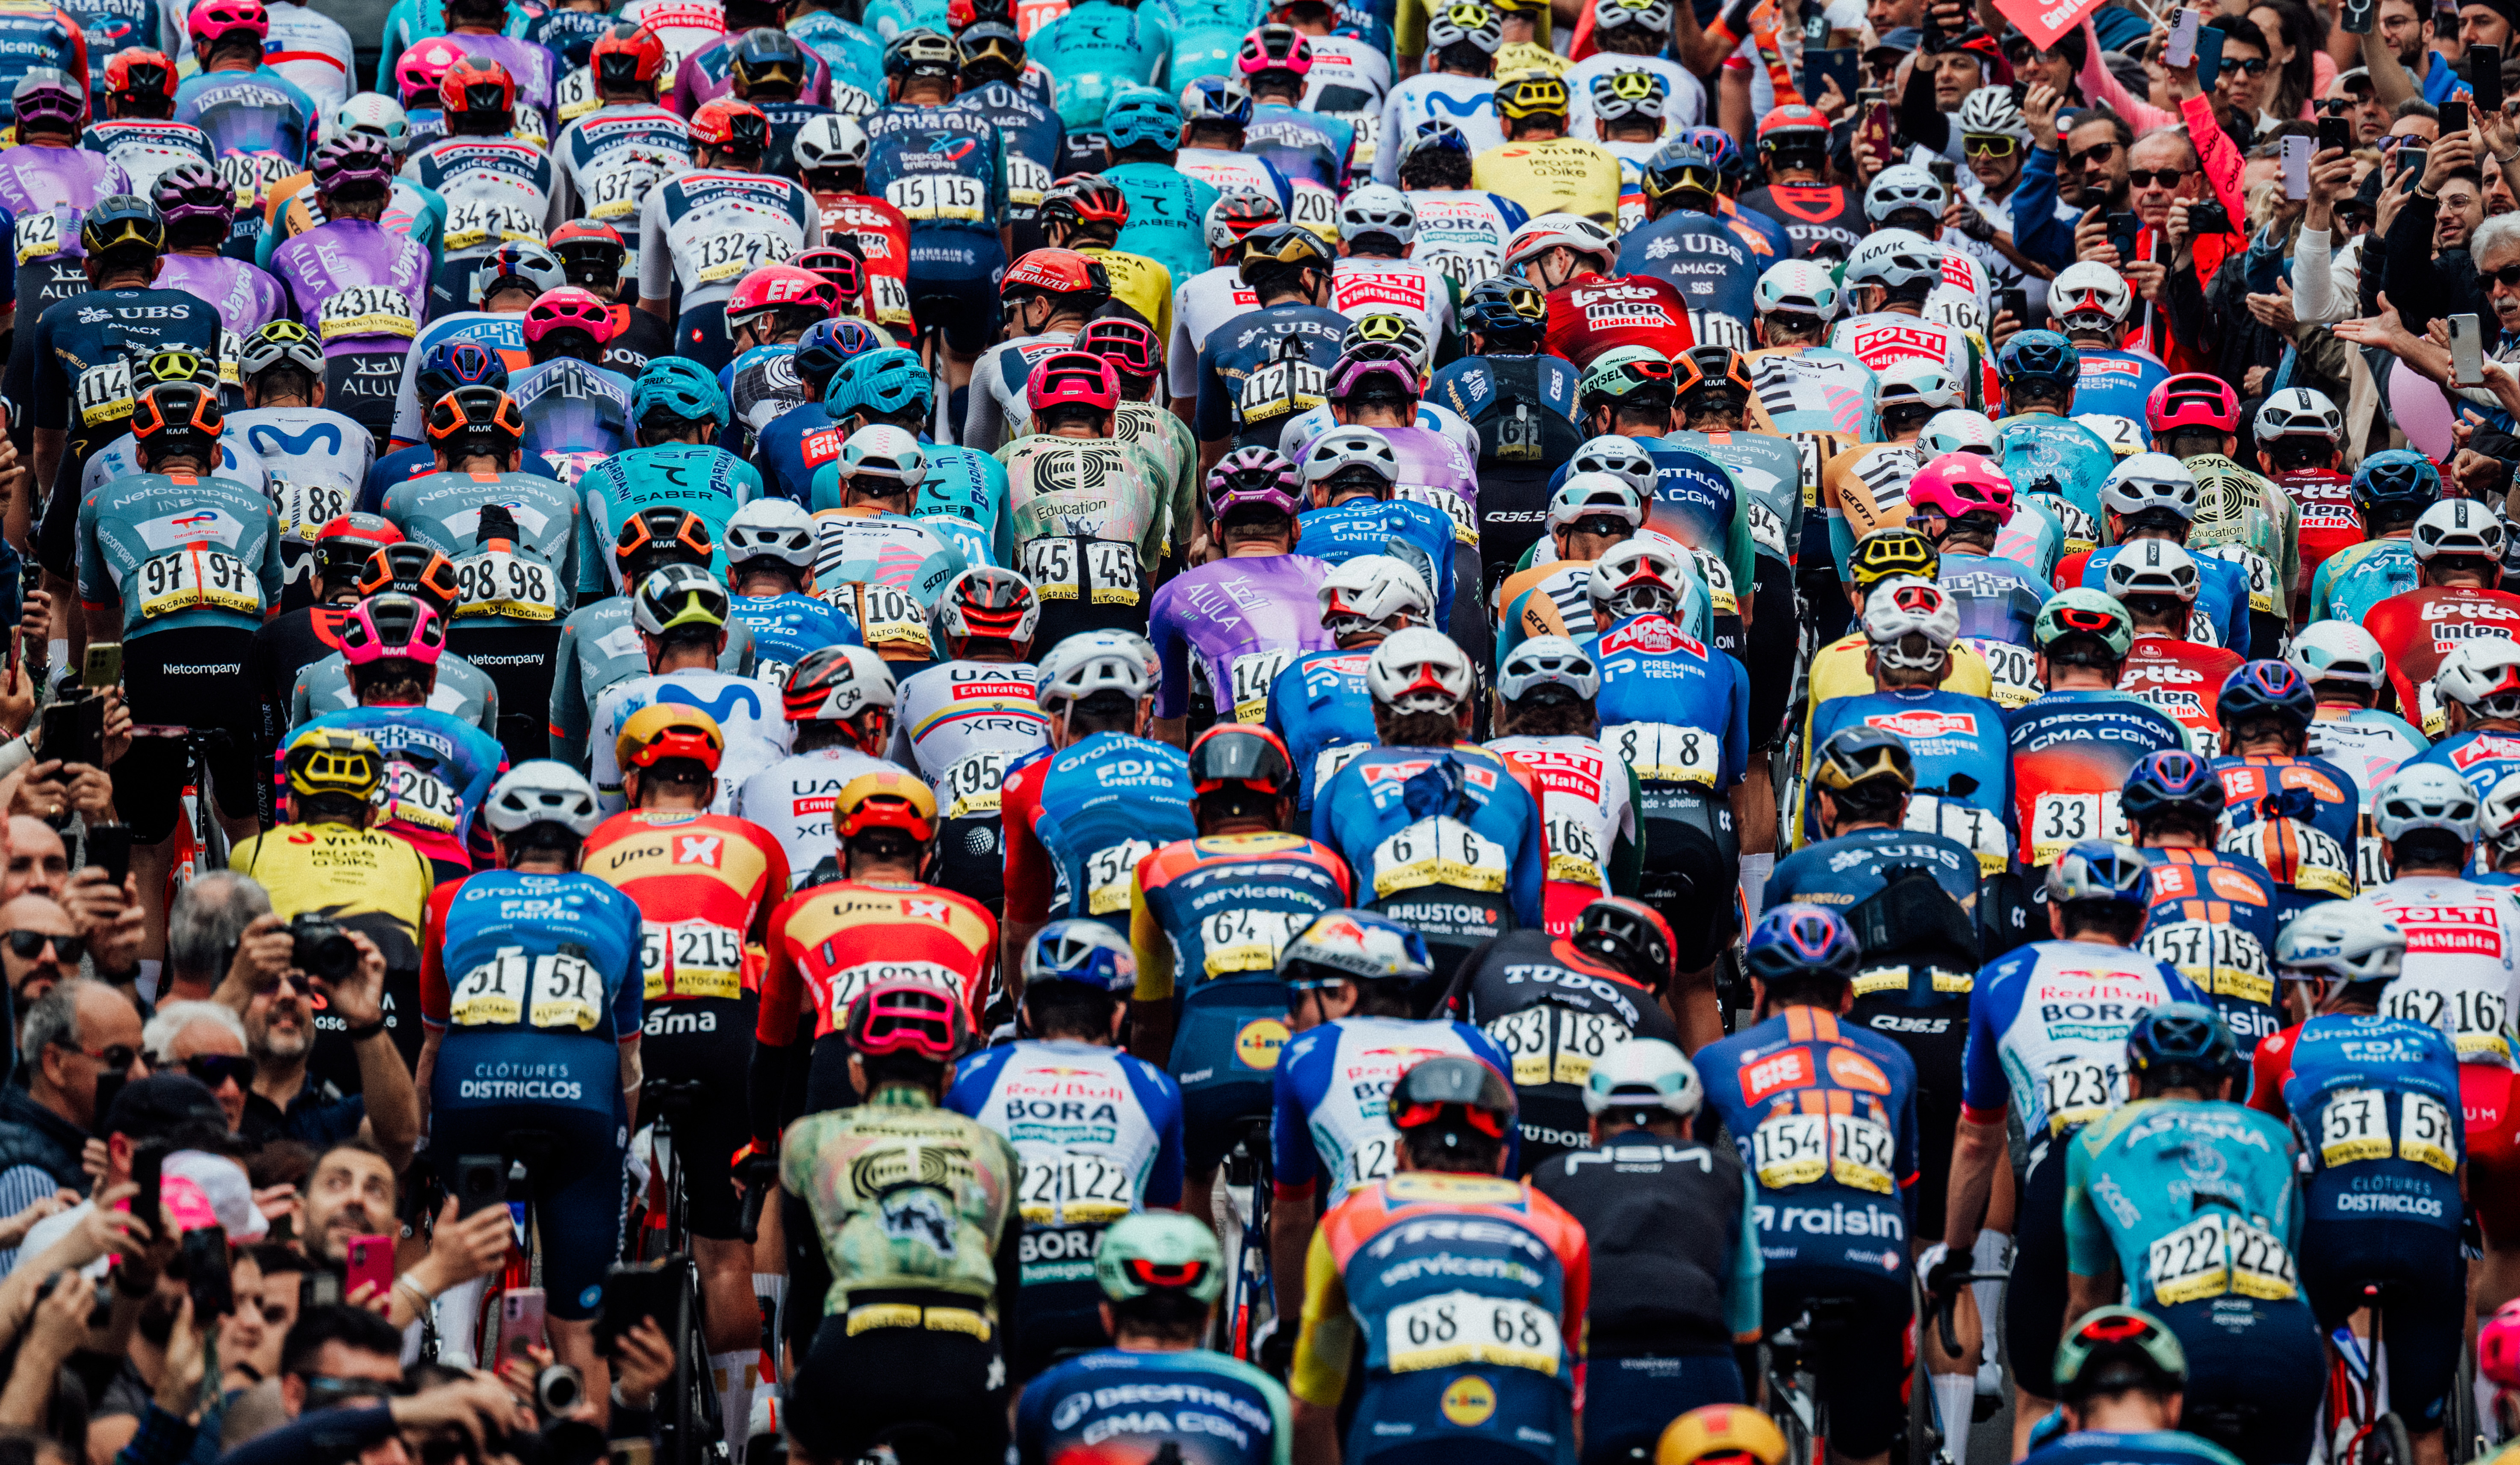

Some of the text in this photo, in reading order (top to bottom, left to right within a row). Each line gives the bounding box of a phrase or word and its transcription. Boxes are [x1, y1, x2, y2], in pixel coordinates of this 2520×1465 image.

[986, 85, 1045, 121] UBS
[593, 170, 629, 203] 137
[1008, 161, 1048, 192] 118
[897, 178, 925, 208] 15
[946, 180, 976, 207] 15
[16, 214, 55, 253] 142
[1125, 218, 1188, 230] SABER
[1683, 233, 1743, 268] UBS
[1862, 241, 1905, 262] KASK
[1671, 262, 1727, 275] AMACX
[1006, 270, 1070, 291] SPECIALIZED
[1334, 274, 1422, 290] POLTI
[1691, 281, 1713, 294] SGS
[221, 266, 253, 323] Jayco
[1341, 286, 1422, 307] VisitMalta
[1571, 286, 1658, 307] Lotto
[116, 304, 190, 319] UBS
[1463, 307, 1475, 318] ABUS
[1586, 303, 1670, 321] Inter
[1271, 321, 1341, 341] UBS
[1858, 328, 1944, 354] POLTI
[125, 339, 146, 350] SGS
[55, 348, 88, 369] PINARELLO
[643, 377, 673, 386] BRIKO
[908, 371, 931, 379] BRIKO
[1341, 371, 1354, 388] Jayco
[1399, 368, 1412, 384] Jayco
[1589, 370, 1623, 392] RYSEL
[80, 370, 128, 406] 114
[515, 361, 626, 412] ROCKETS
[1244, 370, 1287, 410] 112
[1468, 377, 1488, 402] UBS
[85, 403, 133, 424] ALTOGRANO
[1246, 406, 1291, 424] ALTOGRANO
[1033, 435, 1119, 449] easypost
[2114, 419, 2131, 444] 2
[2016, 467, 2073, 479] SAMRUK
[113, 485, 259, 512] Netcompany
[309, 484, 343, 524] 88
[417, 482, 564, 506] Netcompany
[632, 490, 713, 504] SABER
[1667, 488, 1715, 510] CGM
[1036, 498, 1107, 520] Education
[1301, 504, 1432, 528] Groupama
[1485, 511, 1546, 522] Q36.5
[1956, 504, 1971, 515] UTOPIA
[173, 529, 219, 540] TotalEnergies
[1329, 518, 1387, 534] FDJ
[97, 527, 140, 570] Netcompany
[1031, 538, 1051, 546] RAFFERTY
[461, 557, 477, 566] TURNER
[1036, 545, 1069, 583] 45
[1098, 549, 1131, 590] 45
[146, 554, 184, 596] 97
[212, 554, 248, 593] 97
[458, 560, 495, 603] 98
[508, 560, 546, 602] 98
[923, 569, 951, 592] SCOTT
[393, 582, 418, 590] KASK
[144, 596, 199, 616] ALTOGRANO
[204, 596, 256, 613] ALTOGRANO
[501, 606, 555, 620] ALTOGRANO
[868, 592, 923, 623] 105
[870, 627, 926, 640] ALTOGRANO
[1610, 620, 1697, 649] Alpecin
[382, 647, 407, 656] KASK
[467, 654, 545, 667] Netcompany
[162, 663, 241, 675] Netcompany
[951, 669, 1036, 682] UAE
[1642, 660, 1706, 679] PREMIER
[1645, 668, 1684, 679] TECH
[961, 684, 1030, 696] Emirates
[964, 718, 1037, 736] XRG
[2039, 713, 2175, 743] DECATHLON
[1620, 730, 1636, 763] 8
[1681, 733, 1698, 766] 8
[1909, 740, 1979, 752] PREMIER
[1912, 748, 1957, 756] TECH
[2029, 730, 2157, 753] CMA CGM
[949, 755, 1003, 803] 195
[1964, 810, 1983, 850] 7
[2045, 801, 2086, 839] 33
[611, 846, 664, 869] Uno
[1393, 838, 1413, 862] 6
[1463, 833, 1479, 865] 6
[1880, 845, 1960, 870] UBS
[465, 882, 610, 905] Groupama
[501, 898, 562, 912] FDJ
[1387, 904, 1484, 923] BRUSTOR
[1213, 912, 1256, 944] 64
[1504, 964, 1640, 1028] TUDOR
[1870, 1014, 1951, 1034] Q36.5
[475, 1062, 569, 1079] CLÔTURES
[460, 1080, 582, 1099] DISTRICLOS
[2331, 1100, 2372, 1140] 57
[2352, 1175, 2432, 1197] CLÔTURES
[2337, 1195, 2443, 1218] DISTRICLOS
[1781, 1200, 1904, 1241] raisin
[1408, 1305, 1458, 1345] 68
[1493, 1304, 1542, 1348] 68
